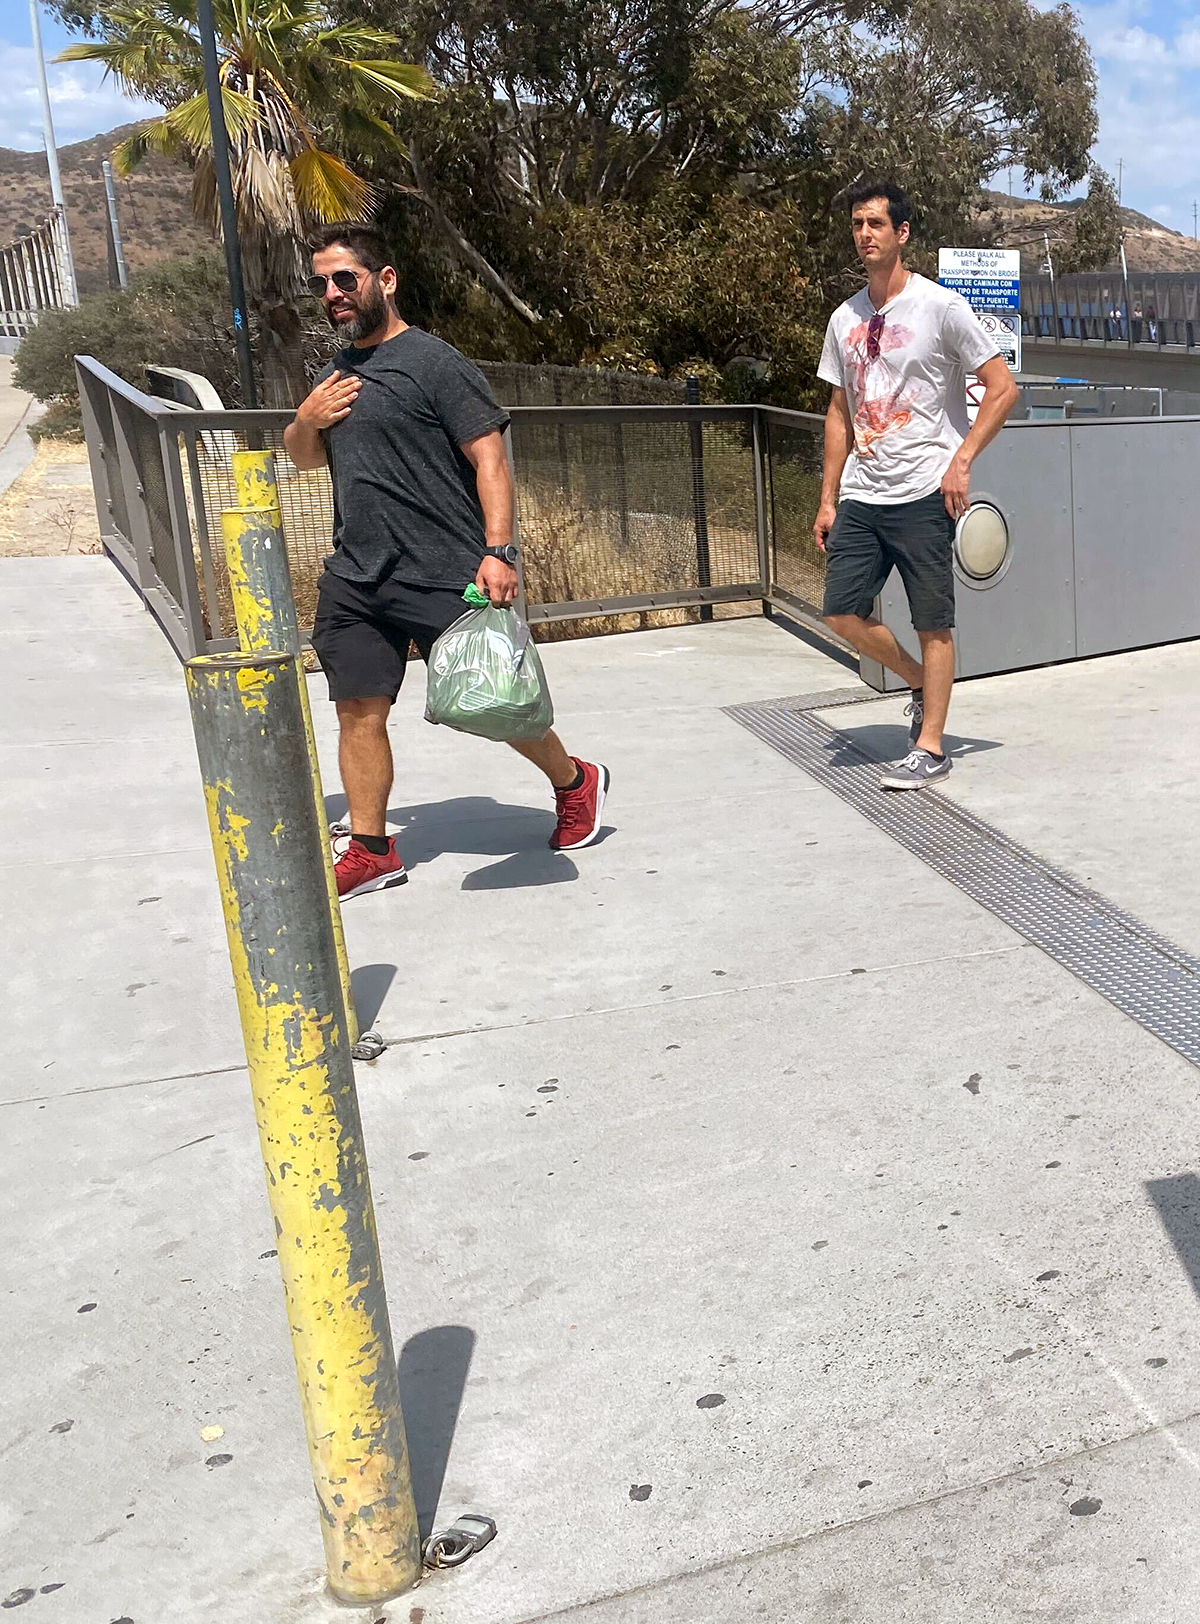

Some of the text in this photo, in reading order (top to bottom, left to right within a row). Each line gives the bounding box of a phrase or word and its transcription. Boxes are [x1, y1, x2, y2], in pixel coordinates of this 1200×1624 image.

[953, 250, 976, 258] PLEASE
[977, 251, 994, 259] WALK
[940, 268, 988, 277] TRANSPORTION
[998, 270, 1018, 278] BRIDGE
[944, 278, 963, 286] FAVOR
[958, 287, 971, 295] TIPO
[981, 288, 1018, 296] TRANSPORTE
